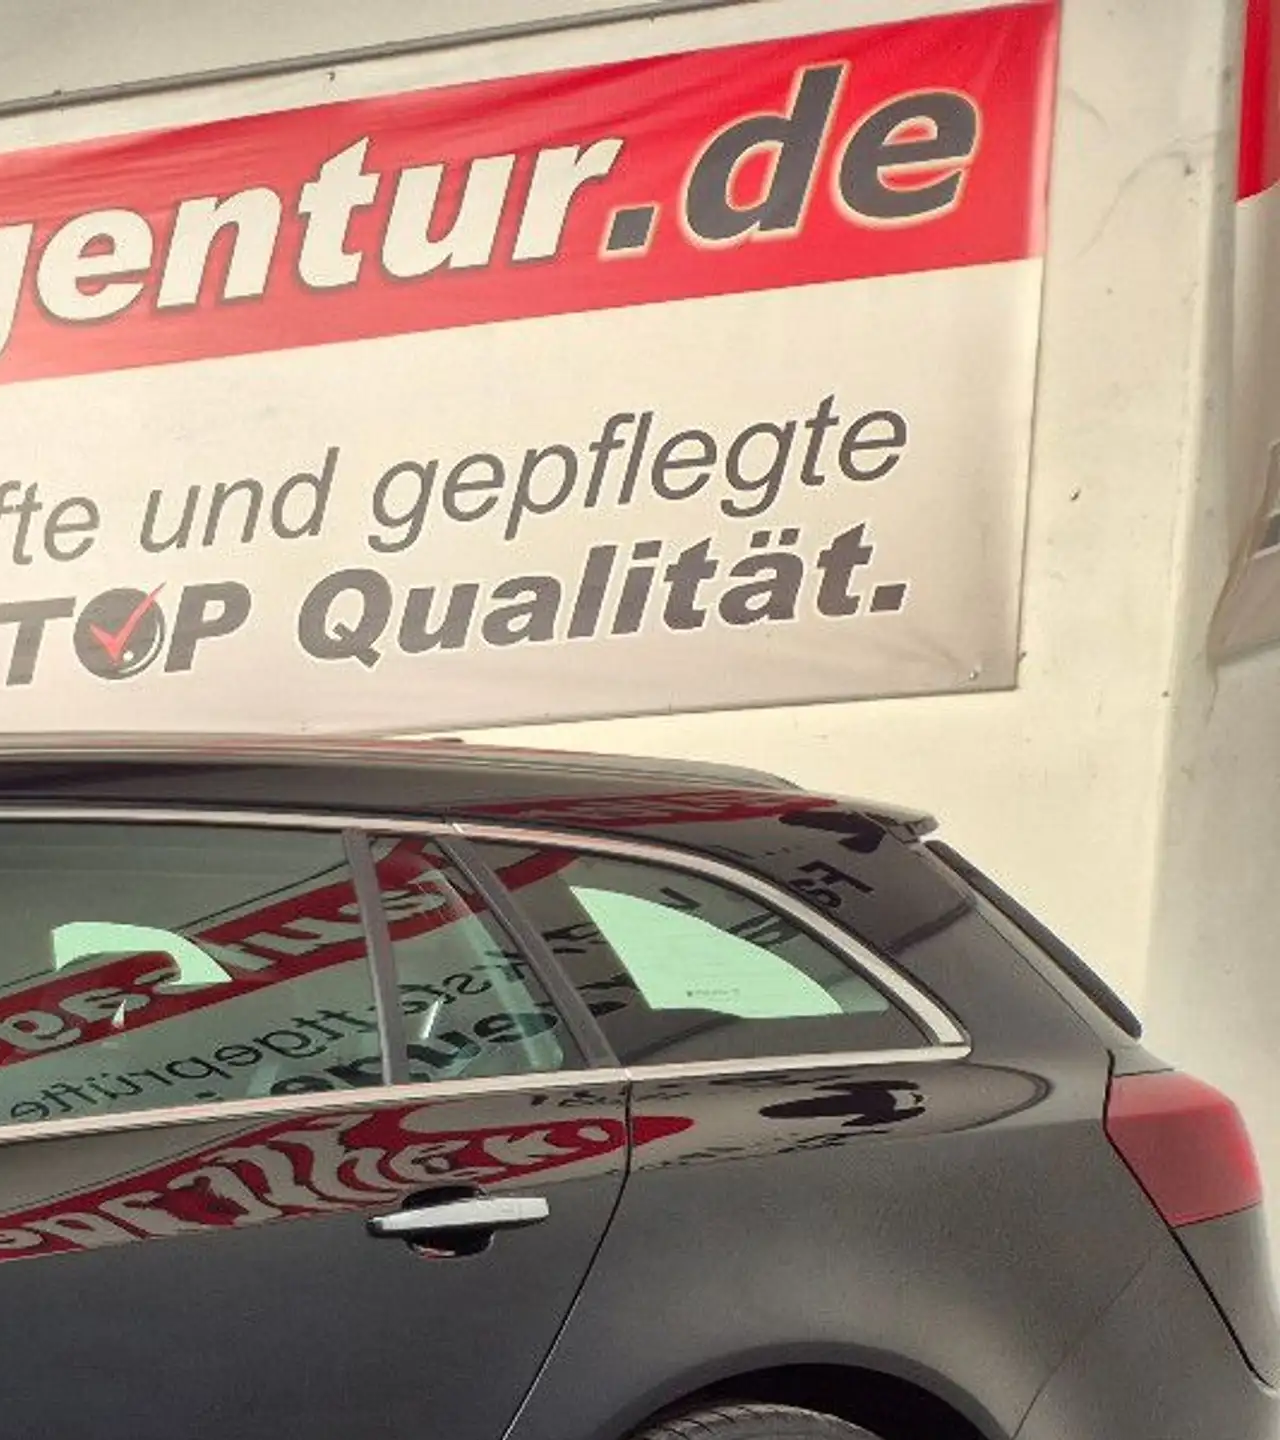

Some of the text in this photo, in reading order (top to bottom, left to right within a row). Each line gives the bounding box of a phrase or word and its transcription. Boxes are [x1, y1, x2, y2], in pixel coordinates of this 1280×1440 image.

[136, 448, 340, 556] und
[372, 393, 908, 554] gepflegte
[296, 520, 908, 668] Qualität.
